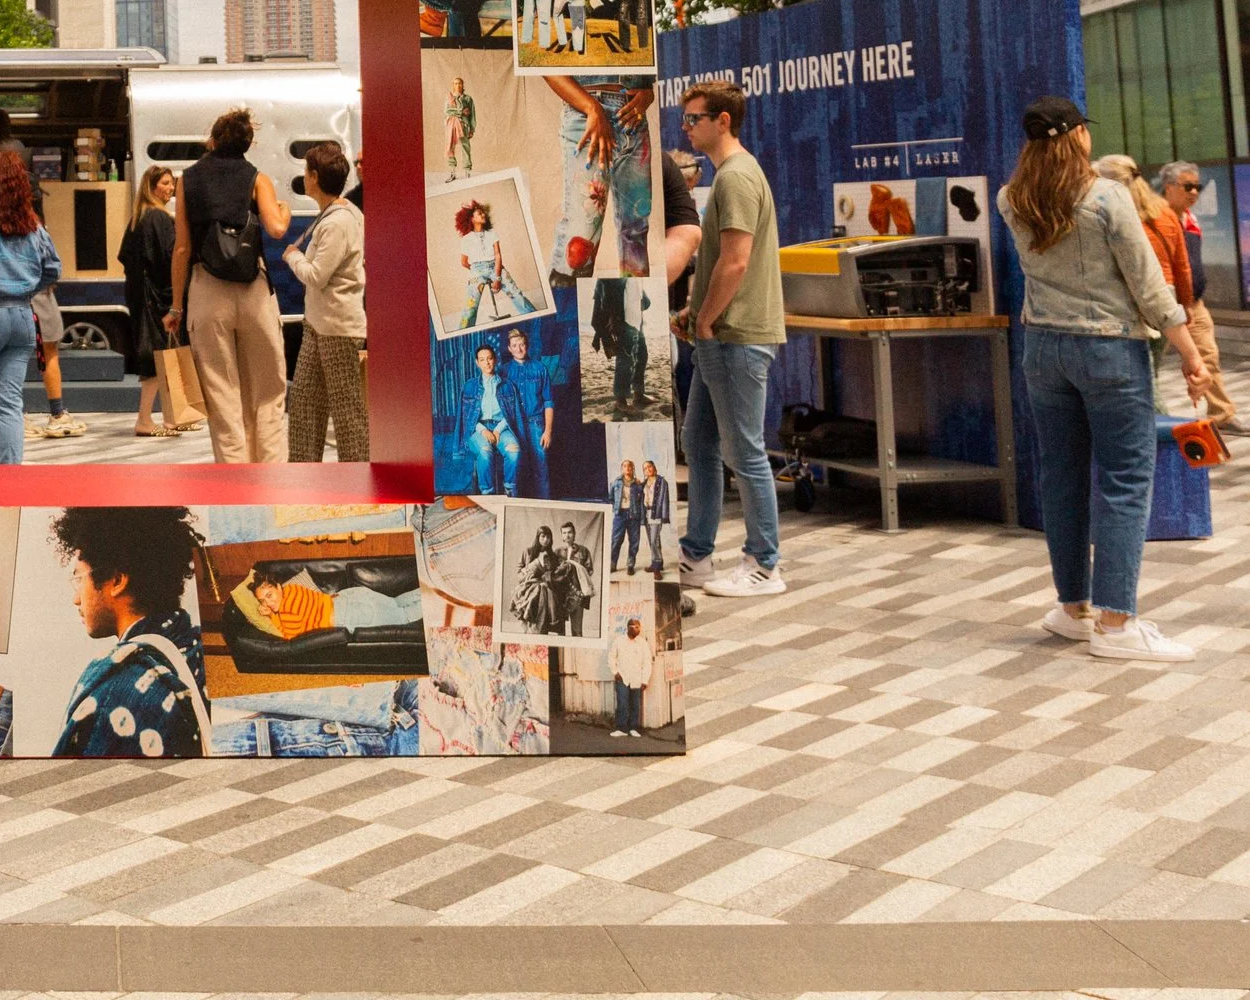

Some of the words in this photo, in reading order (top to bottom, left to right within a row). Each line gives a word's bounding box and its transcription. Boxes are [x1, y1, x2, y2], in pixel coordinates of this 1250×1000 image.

[656, 75, 691, 108] TART
[741, 63, 772, 98] 501
[778, 50, 856, 93] JOURNEY
[861, 41, 914, 82] HERE
[854, 156, 877, 168] LAB
[884, 155, 899, 167] #4
[916, 151, 959, 166] LASER
